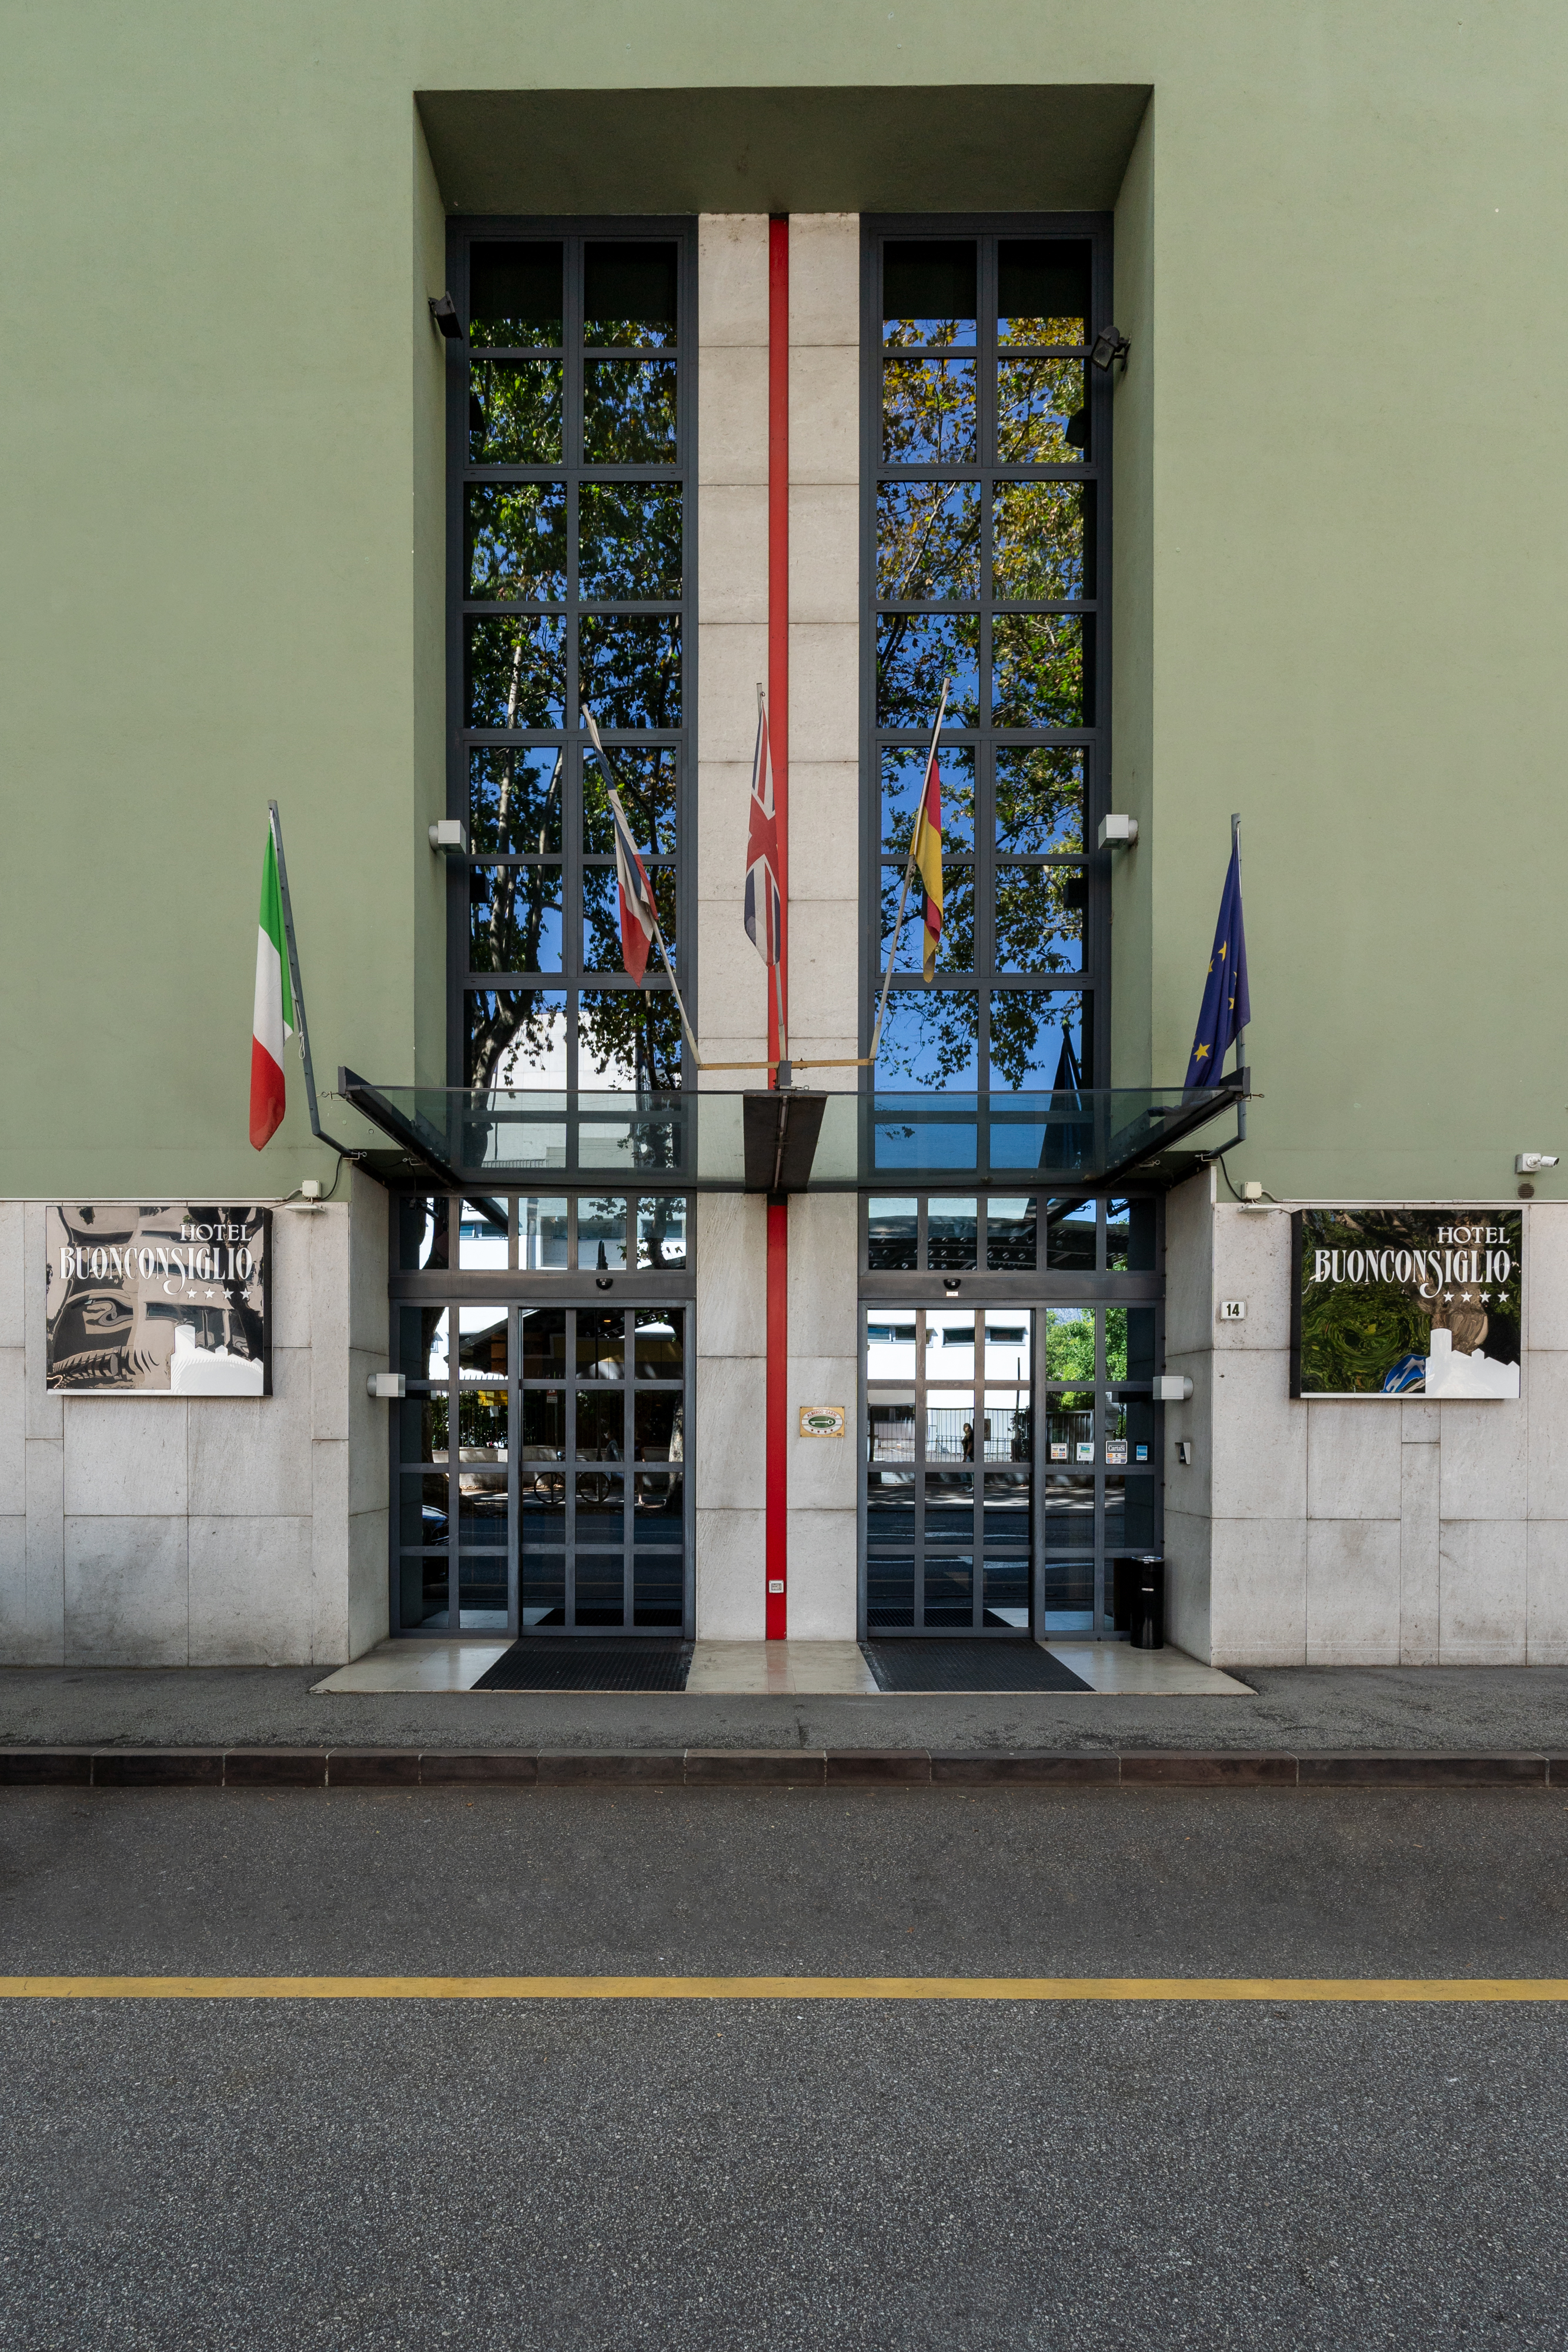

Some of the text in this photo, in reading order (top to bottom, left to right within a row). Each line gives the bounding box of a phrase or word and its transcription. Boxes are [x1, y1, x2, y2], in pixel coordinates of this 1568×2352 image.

[180, 1224, 252, 1241] HOTEL
[1437, 1227, 1510, 1244] HOTEL
[59, 1247, 252, 1295] BUONCONSIGLIO
[1315, 1250, 1510, 1298] BUONCONSIGLIO
[1227, 1304, 1239, 1316] 14
